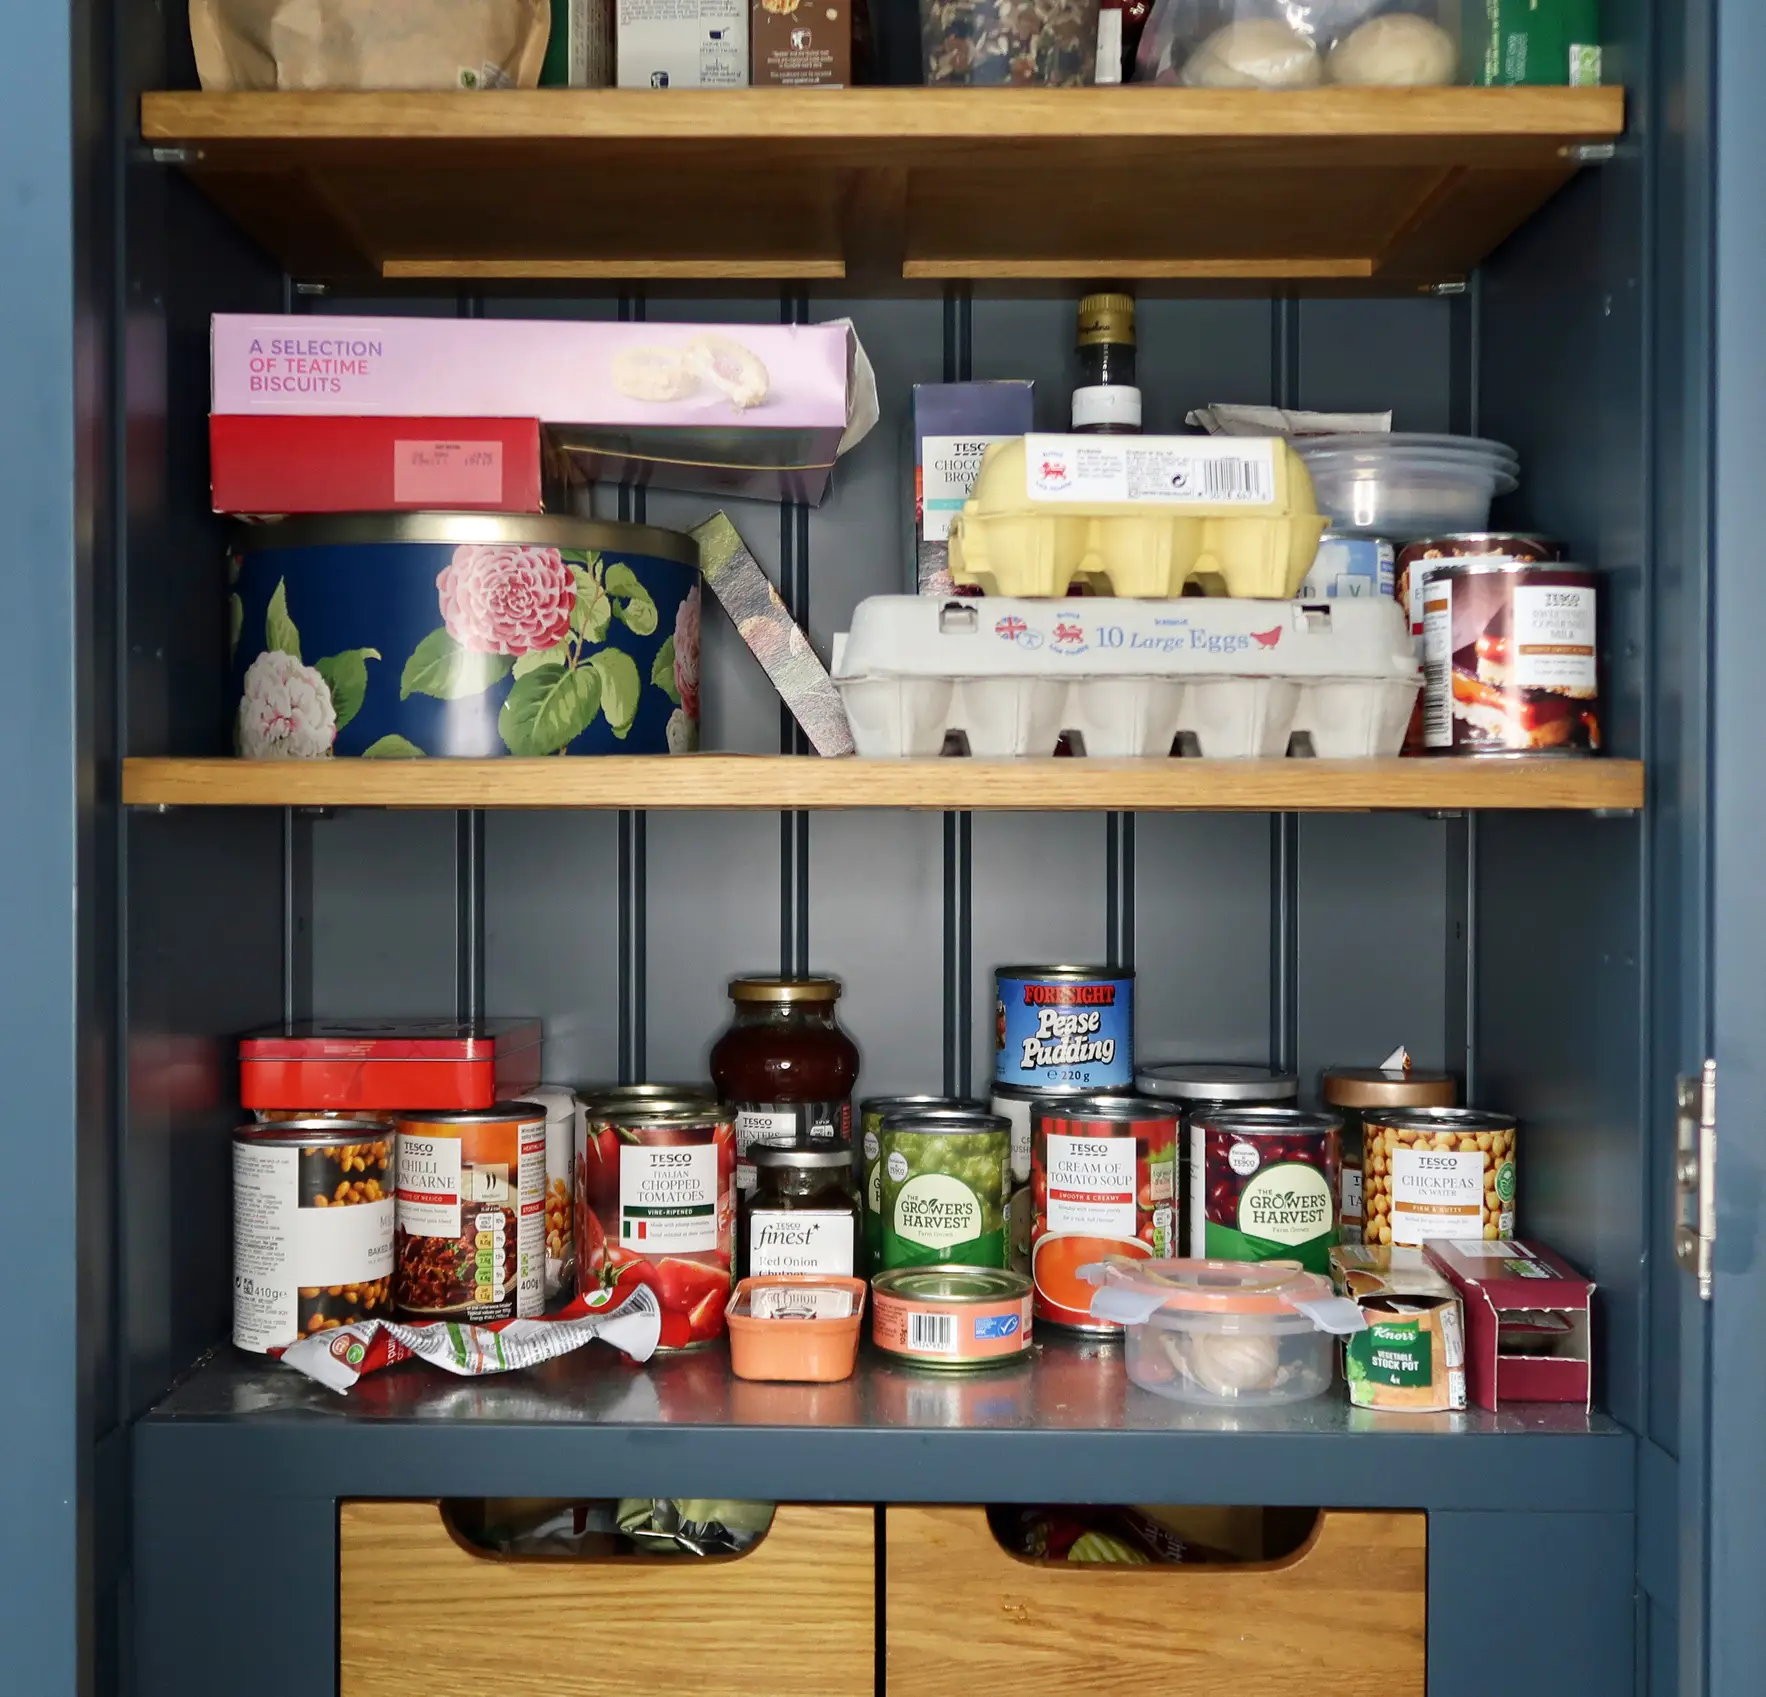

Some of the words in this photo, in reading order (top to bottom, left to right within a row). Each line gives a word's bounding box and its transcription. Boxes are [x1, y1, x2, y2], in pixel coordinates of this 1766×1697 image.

[249, 339, 263, 354] A
[271, 339, 383, 357] SELECTION
[249, 358, 277, 373] OF
[284, 358, 370, 375] TEATIME
[250, 376, 342, 393] BISCUITS
[953, 443, 988, 452] TESC
[1096, 626, 1124, 648] 10
[1130, 632, 1185, 652] Large
[1189, 628, 1249, 653] Eggs
[1024, 985, 1115, 1006] FORESIGHT
[1036, 1008, 1101, 1040] Pease
[1020, 1035, 1115, 1070] Pudding
[743, 1117, 772, 1126] TESCO
[404, 1141, 433, 1152] TESCO
[1070, 1143, 1108, 1153] TESCO
[650, 1153, 692, 1163] TESCO
[1419, 1157, 1458, 1166] TESCO
[401, 1159, 437, 1174] CHILLI
[1058, 1160, 1101, 1174] CREAM
[1105, 1163, 1122, 1173] OF
[411, 1175, 456, 1189] CARNE
[653, 1171, 689, 1179] ITALIAN
[1050, 1171, 1098, 1186] TOMATO
[1100, 1175, 1132, 1187] SOUP
[1402, 1175, 1475, 1189] CHICKPEAS
[641, 1179, 700, 1190] CHOPPED
[637, 1191, 704, 1203] TOMATOES
[1250, 1191, 1326, 1209] GROWER'S
[1428, 1189, 1457, 1197] WATER
[647, 1208, 693, 1216] VINE-RIPENED
[901, 1198, 973, 1215] GROWER'S
[1412, 1204, 1430, 1212] FIRM
[903, 1214, 971, 1229] HARVEST
[1253, 1210, 1325, 1224] HARVEST
[754, 1225, 813, 1250] finest
[368, 1244, 389, 1257] BAKED
[760, 1257, 780, 1266] Red
[783, 1257, 818, 1267] Onion
[1372, 1326, 1416, 1341] Knorr
[1377, 1350, 1412, 1361] VEGETABLE
[1372, 1356, 1400, 1370] STOCK
[1401, 1361, 1419, 1371] POT
[1390, 1373, 1400, 1384] 4x
